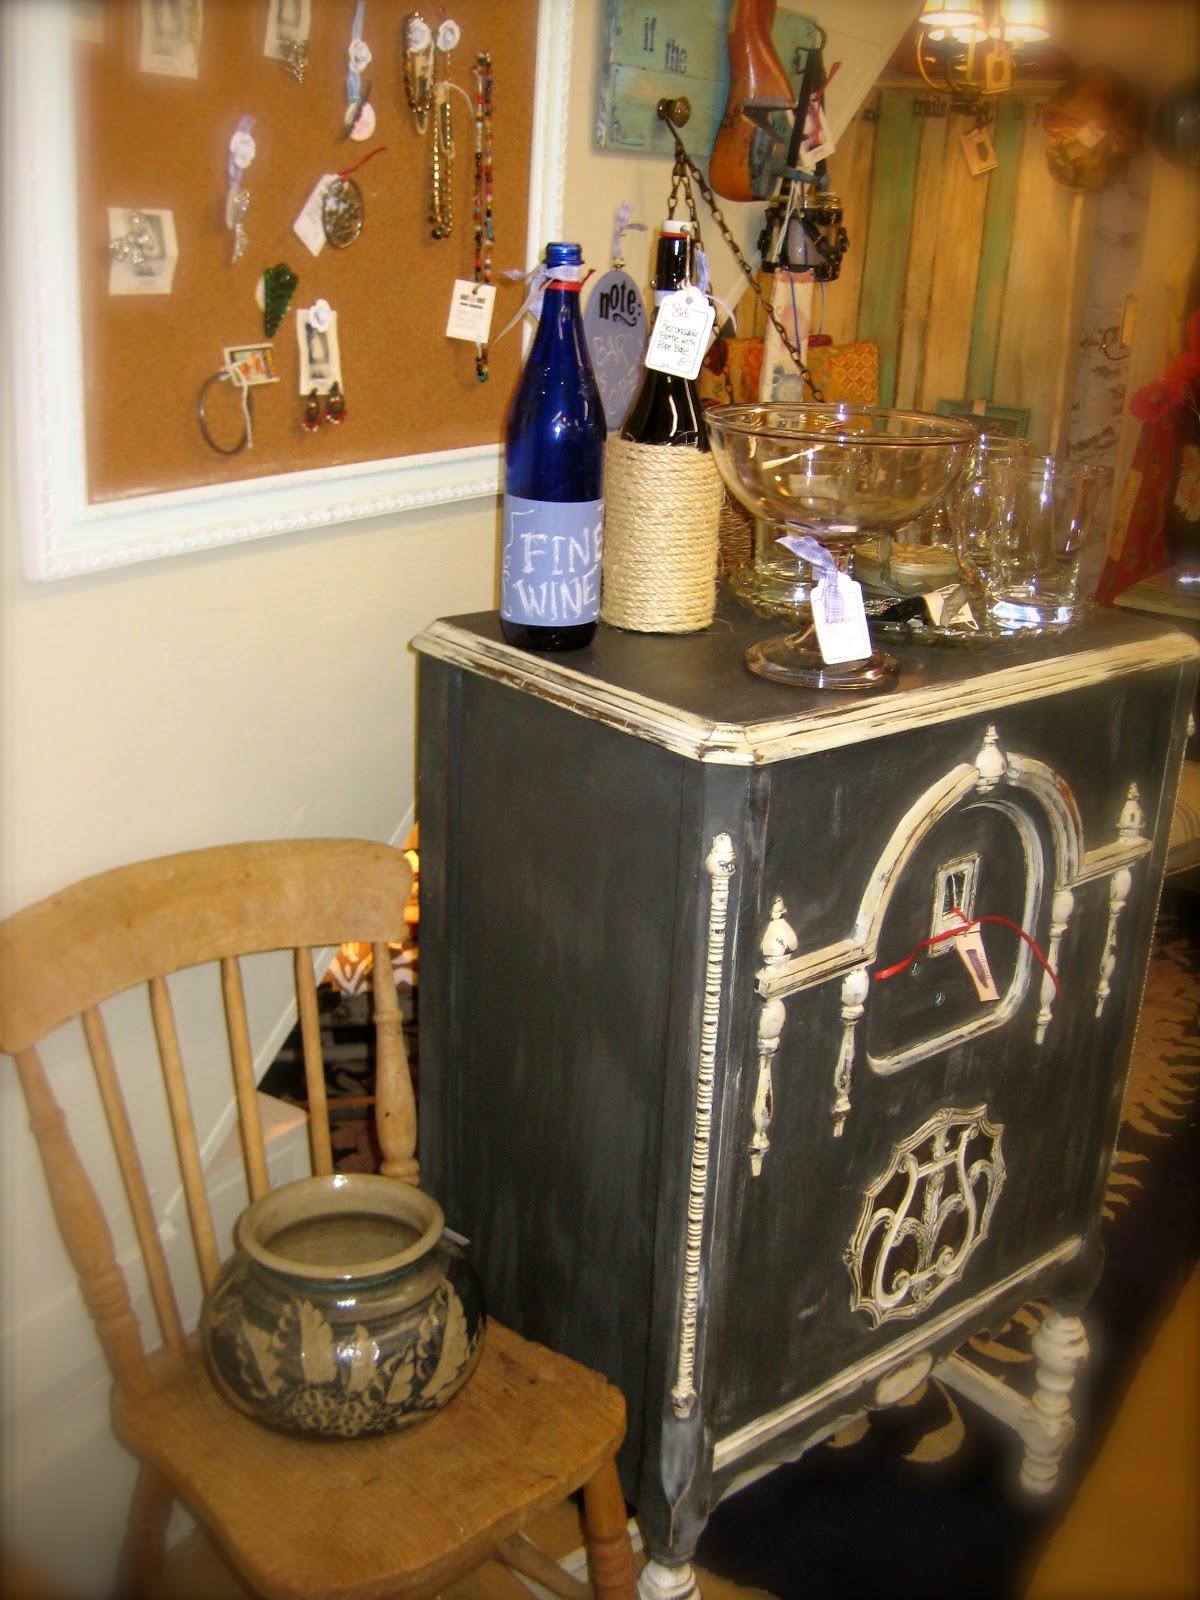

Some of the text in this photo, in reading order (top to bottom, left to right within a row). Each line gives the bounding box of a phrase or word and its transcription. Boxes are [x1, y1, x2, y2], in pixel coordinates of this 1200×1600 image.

[643, 16, 656, 52] if
[664, 38, 688, 74] the
[521, 521, 602, 575] FINE
[512, 563, 598, 621] WINE
